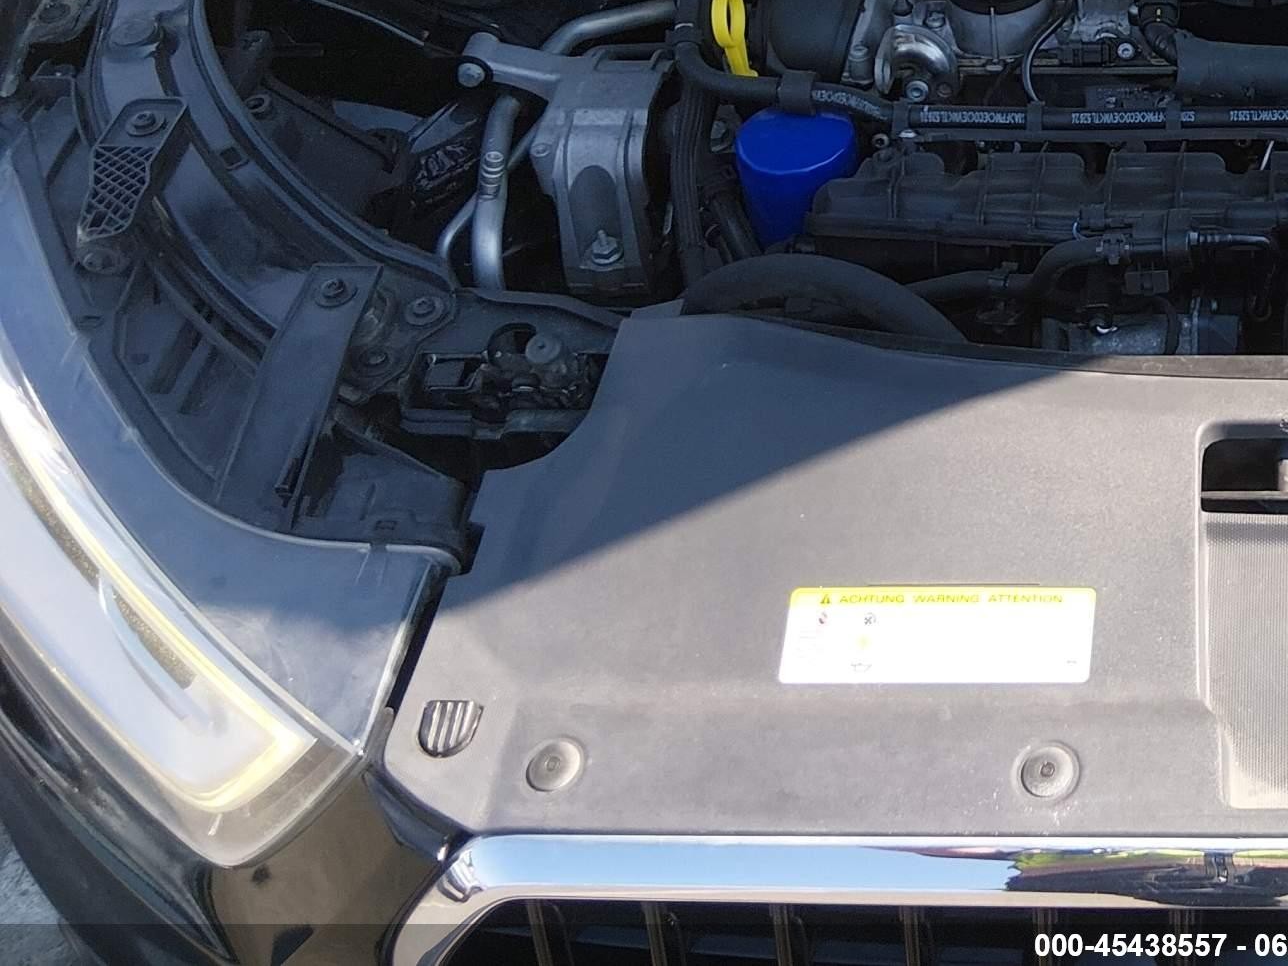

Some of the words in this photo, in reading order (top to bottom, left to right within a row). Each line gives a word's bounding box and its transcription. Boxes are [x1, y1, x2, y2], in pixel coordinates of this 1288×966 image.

[839, 594, 905, 604] ACHTUNG
[913, 594, 980, 604] WARNING
[987, 594, 1064, 604] ATTENTION
